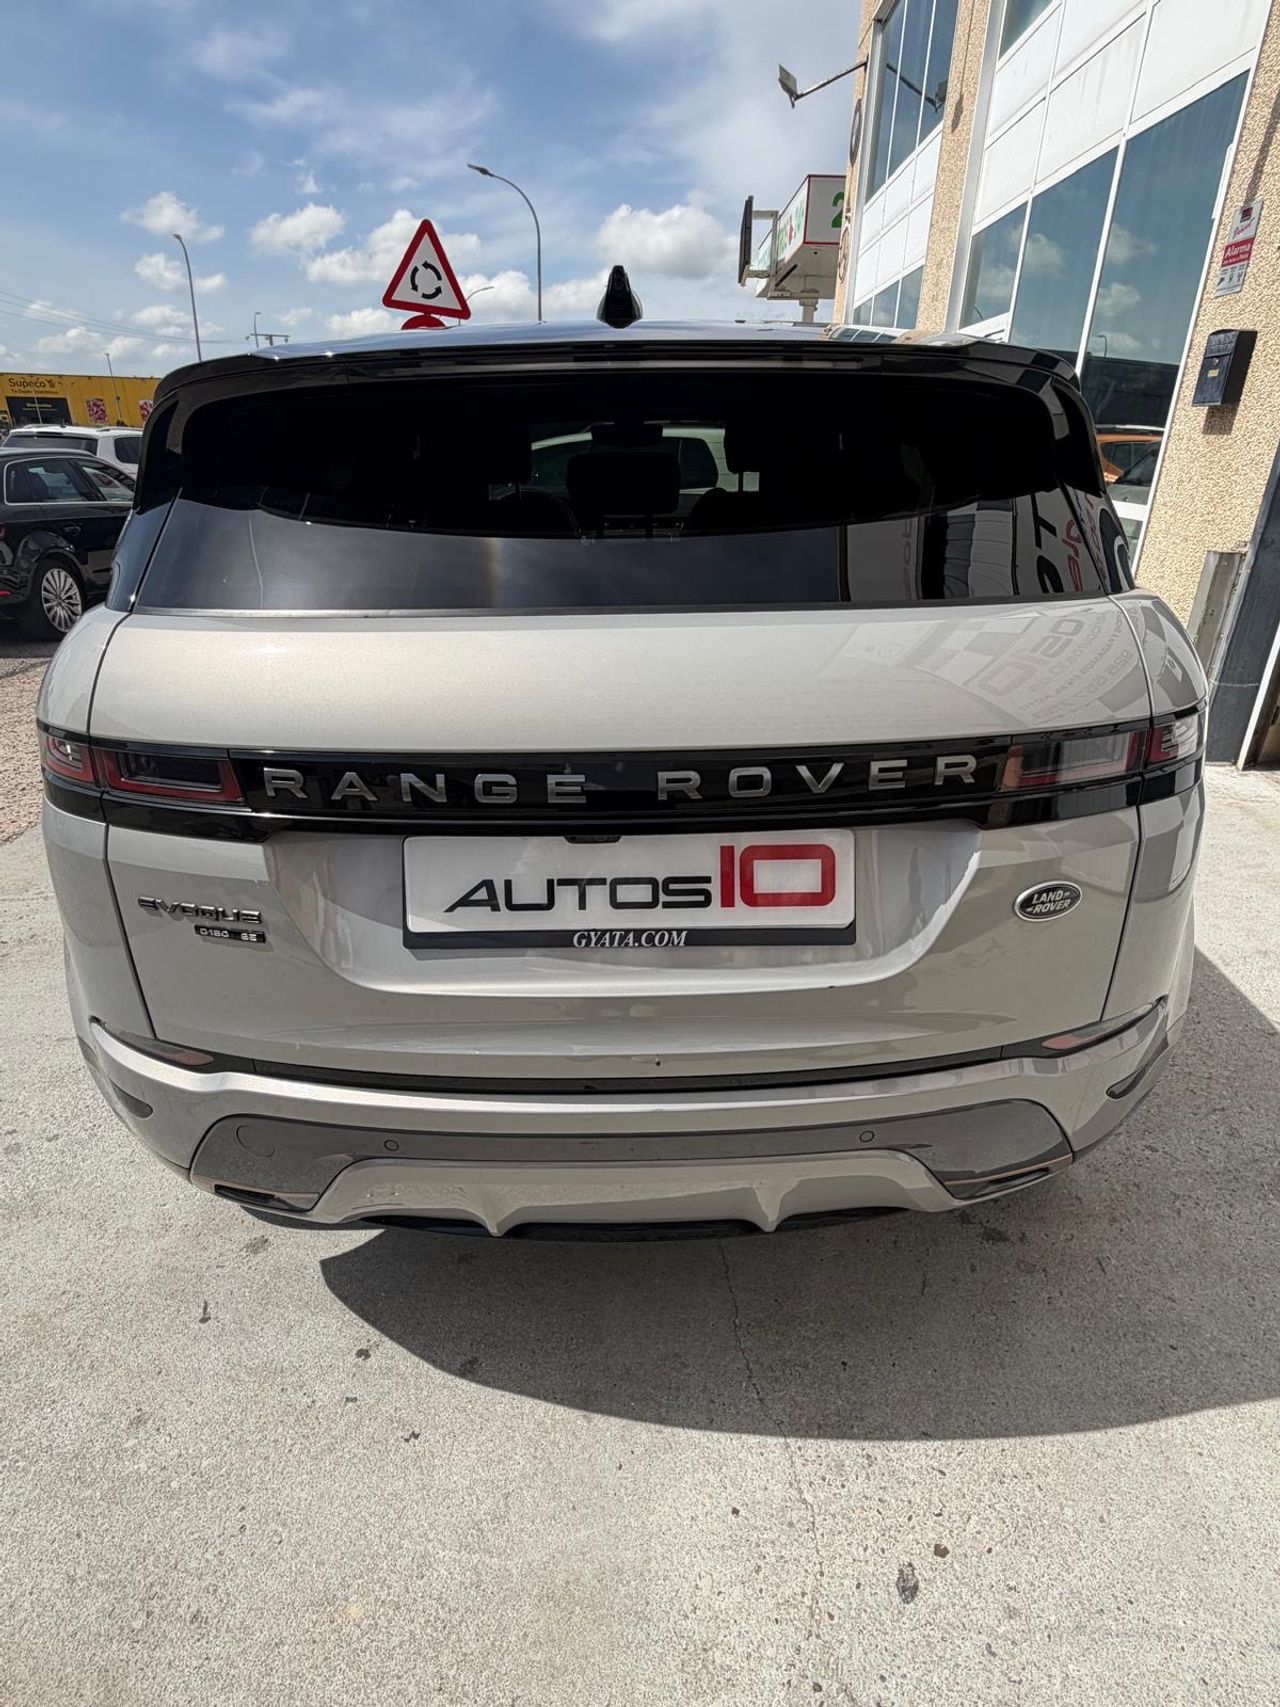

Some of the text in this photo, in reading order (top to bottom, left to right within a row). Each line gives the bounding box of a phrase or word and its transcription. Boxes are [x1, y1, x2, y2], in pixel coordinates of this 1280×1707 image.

[263, 754, 978, 804] RANGE ROVER
[137, 896, 263, 924] EVOQUE
[1032, 899, 1072, 914] ROVER
[572, 930, 688, 947] GYATA.COM
